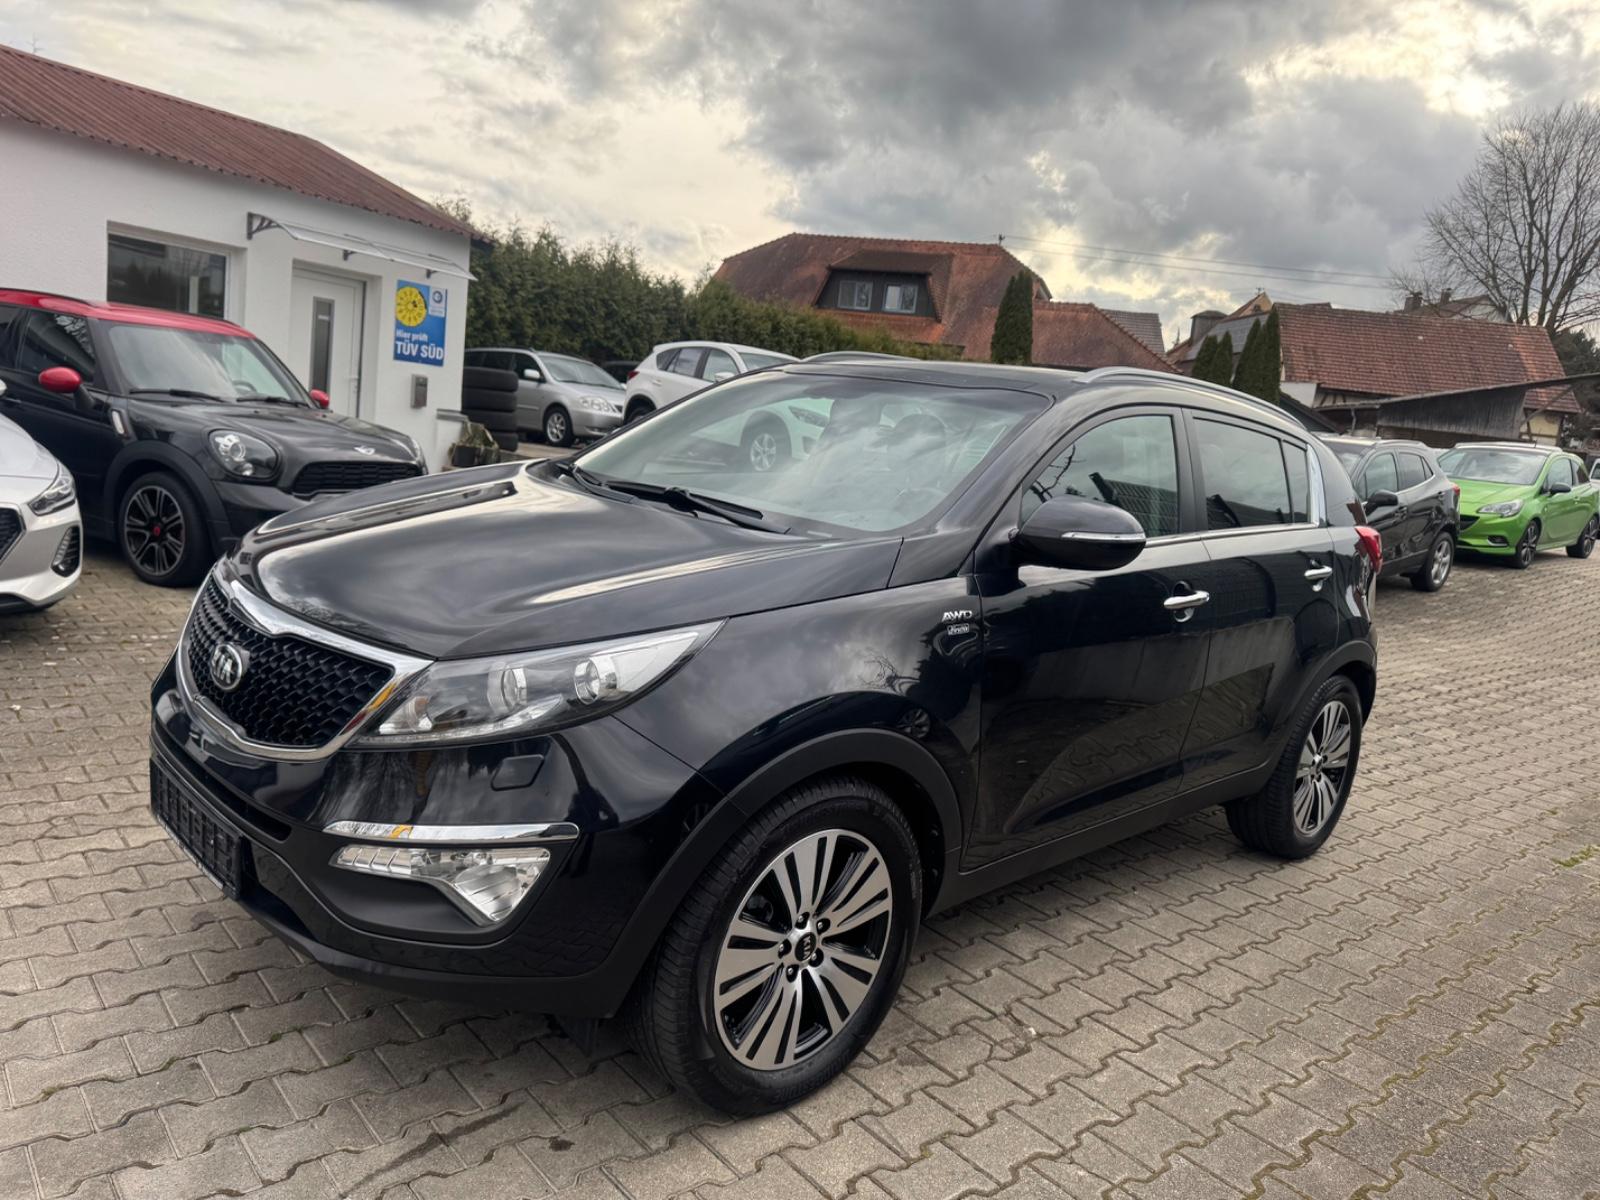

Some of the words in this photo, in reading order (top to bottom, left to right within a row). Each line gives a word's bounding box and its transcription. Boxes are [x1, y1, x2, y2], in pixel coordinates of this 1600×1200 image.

[395, 339, 419, 357] TÜV
[420, 343, 444, 360] SÜD
[941, 610, 973, 622] AWD
[802, 934, 812, 960] KIA
